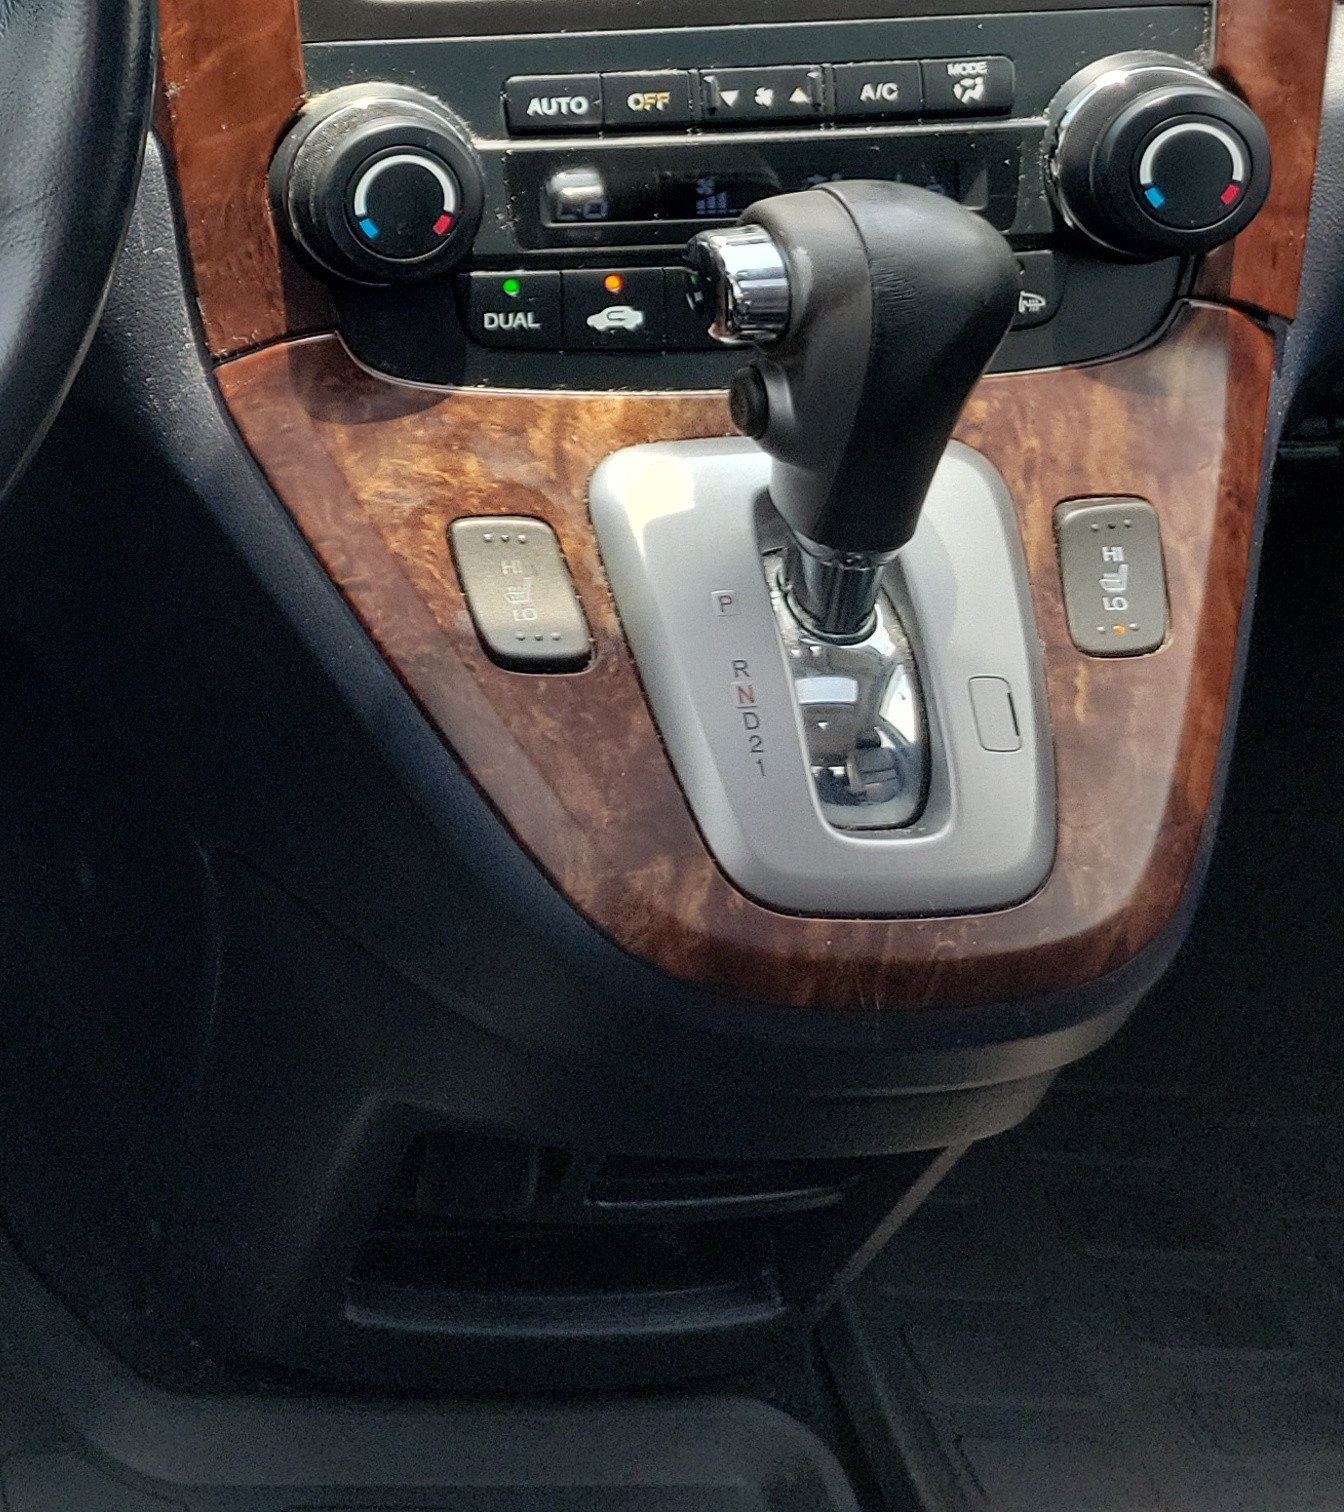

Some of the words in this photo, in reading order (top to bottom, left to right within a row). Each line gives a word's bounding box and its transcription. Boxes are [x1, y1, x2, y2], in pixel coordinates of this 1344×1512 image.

[947, 61, 988, 75] MODE
[627, 91, 670, 111] OFF
[859, 82, 898, 102] A/C
[526, 95, 589, 116] AUTO
[484, 310, 540, 331] DUAL
[717, 594, 733, 613] P
[731, 659, 750, 678] R
[736, 684, 756, 704] N
[742, 711, 760, 731] D
[748, 735, 764, 754] 2
[755, 759, 767, 777] 1
